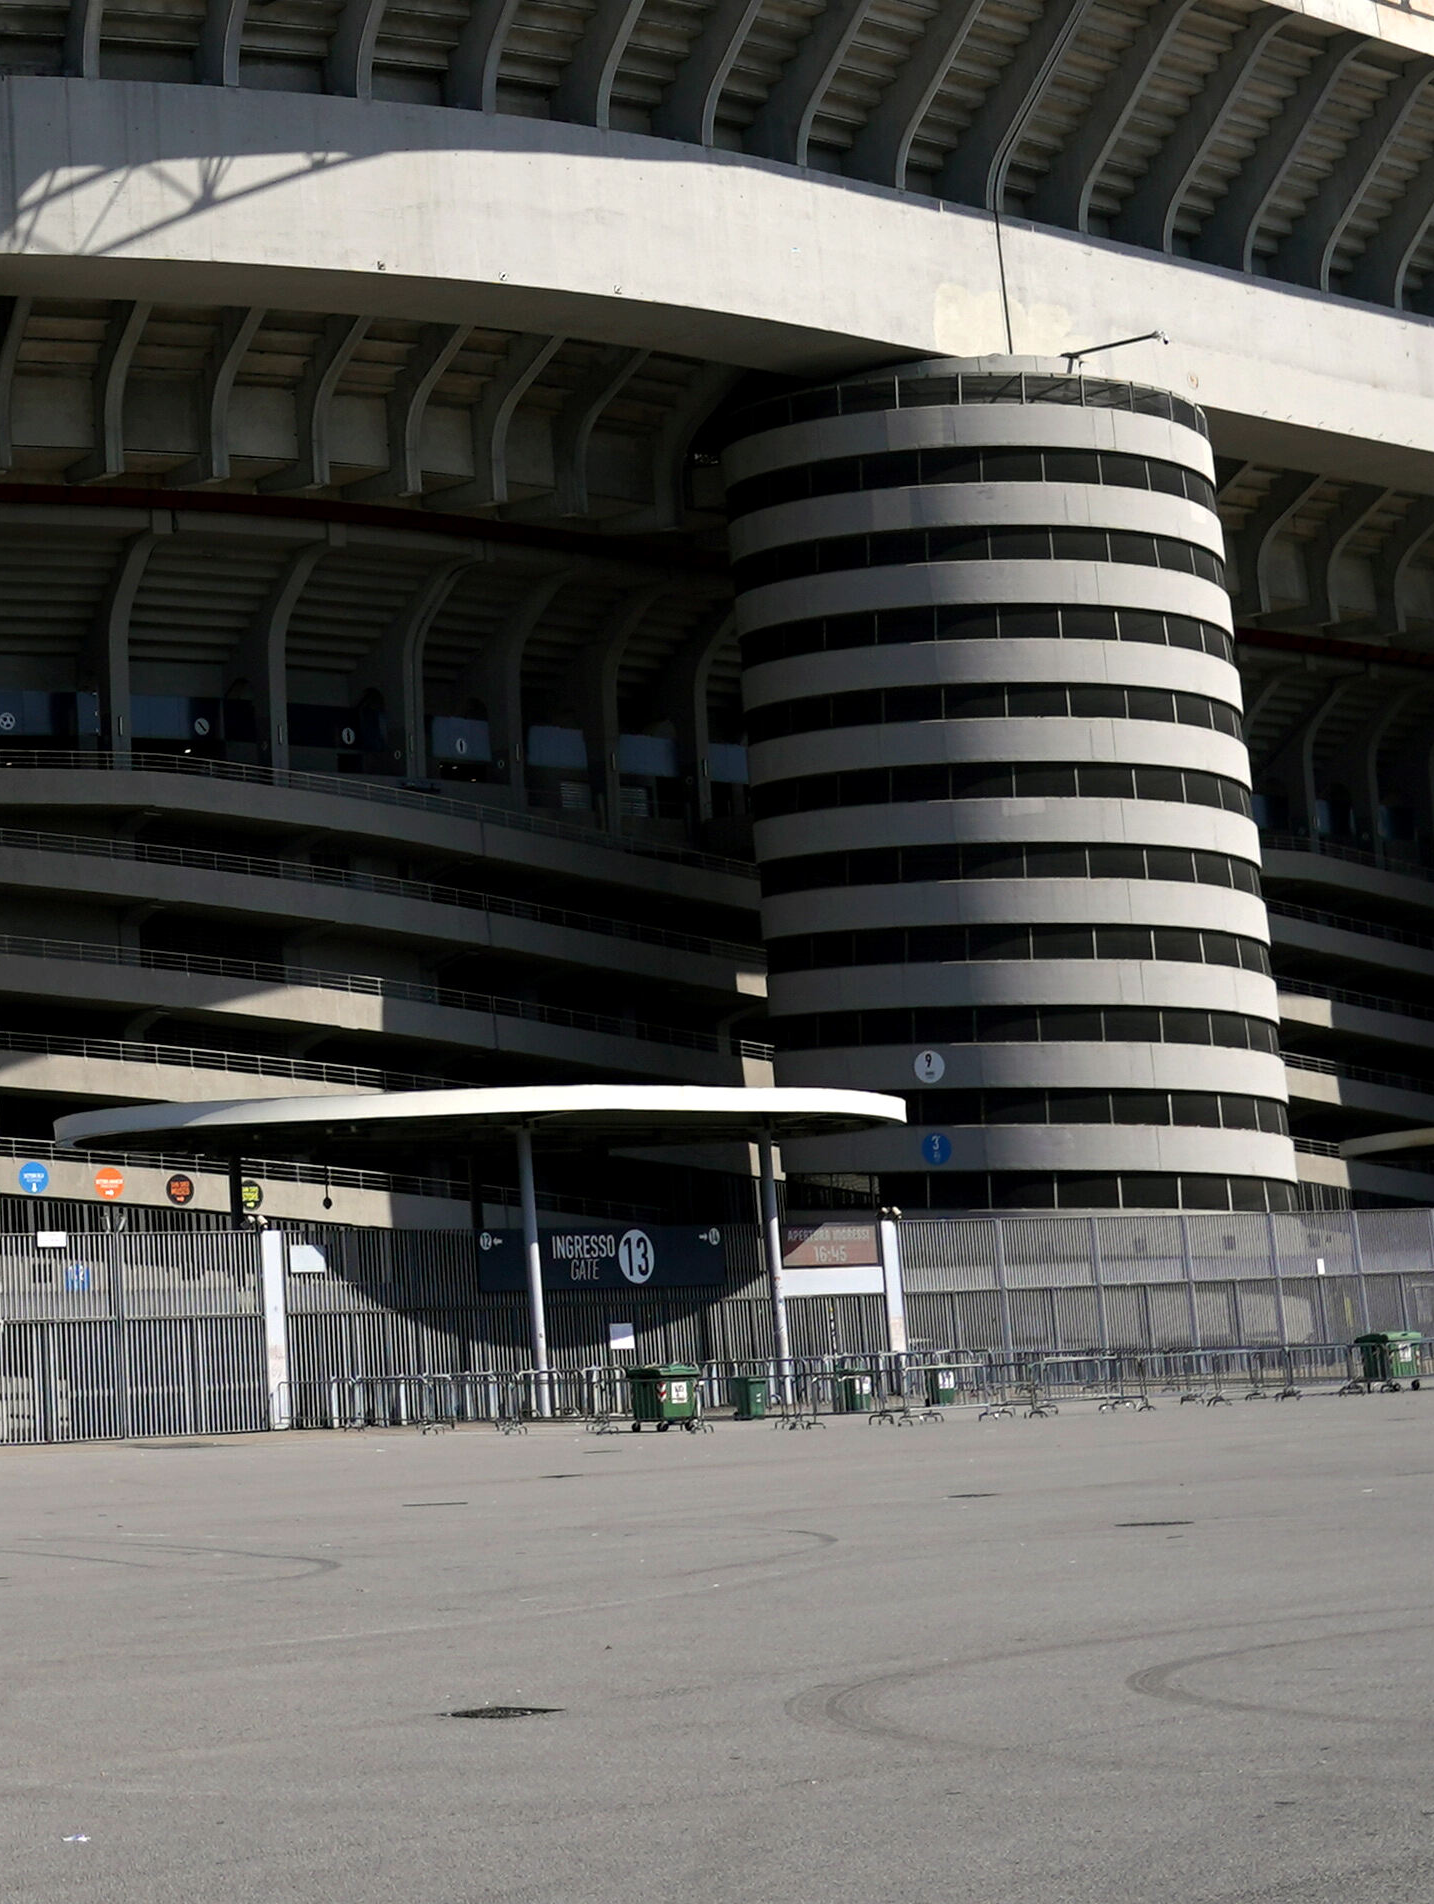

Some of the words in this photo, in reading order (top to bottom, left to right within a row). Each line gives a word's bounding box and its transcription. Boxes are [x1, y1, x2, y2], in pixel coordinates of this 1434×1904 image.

[925, 1053, 932, 1068] 9
[552, 1234, 616, 1260] INGRESSO
[623, 1236, 650, 1277] 13
[813, 1244, 849, 1263] 16:45
[571, 1258, 601, 1281] GATE
